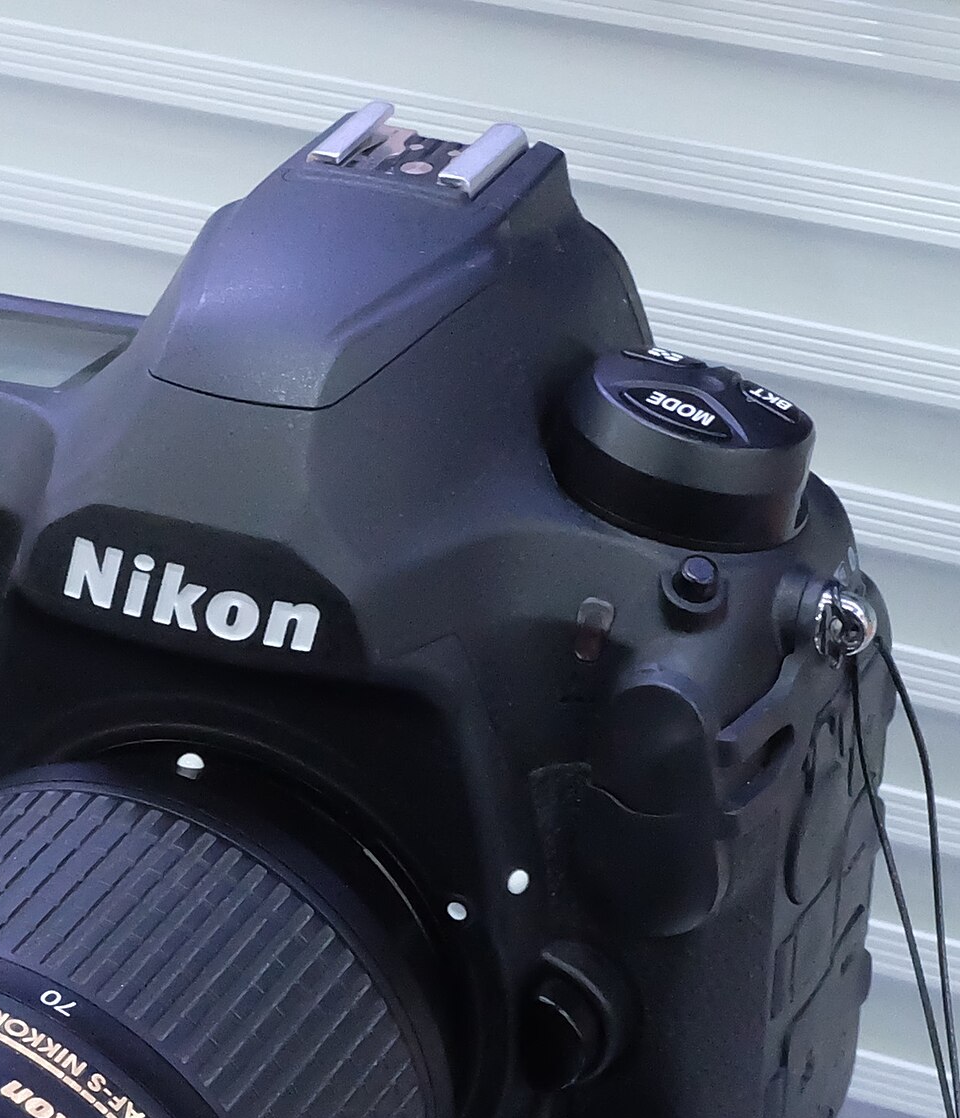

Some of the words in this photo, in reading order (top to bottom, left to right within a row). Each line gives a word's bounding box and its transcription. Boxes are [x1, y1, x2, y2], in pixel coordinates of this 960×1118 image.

[645, 390, 716, 427] MODE
[749, 387, 794, 411] BKT
[63, 536, 321, 653] Nikon
[40, 989, 77, 1017] 70
